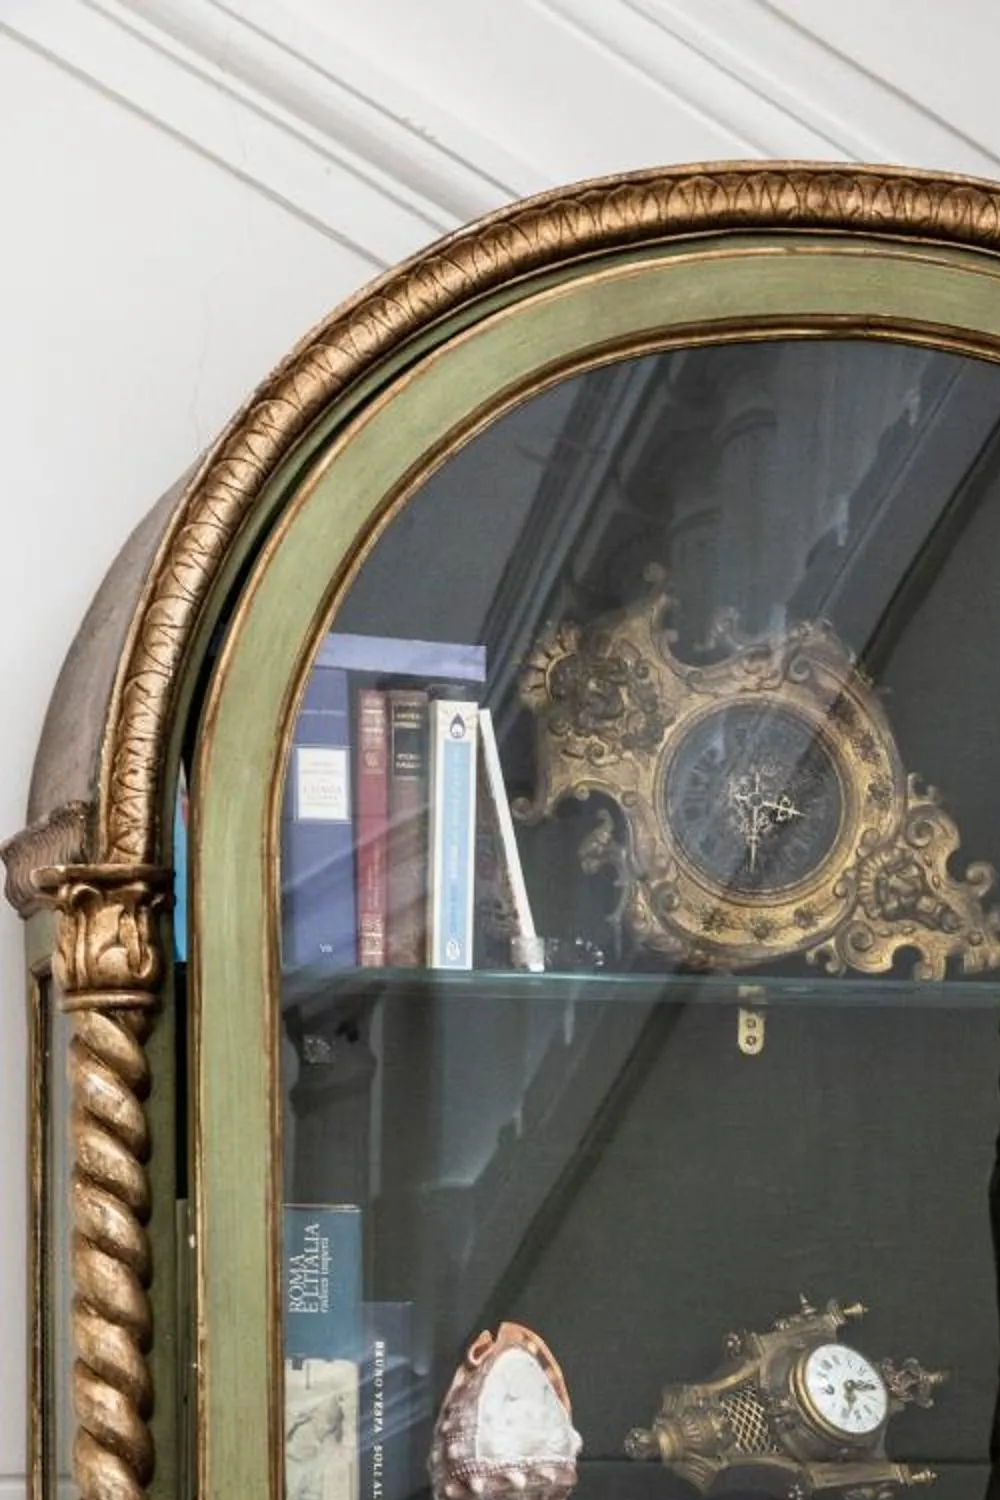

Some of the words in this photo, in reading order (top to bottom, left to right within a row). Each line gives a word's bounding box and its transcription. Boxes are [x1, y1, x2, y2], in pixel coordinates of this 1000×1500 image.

[288, 1253, 305, 1313] ROMA
[374, 1341, 385, 1388] BRUNO
[373, 1391, 384, 1433] VESPA
